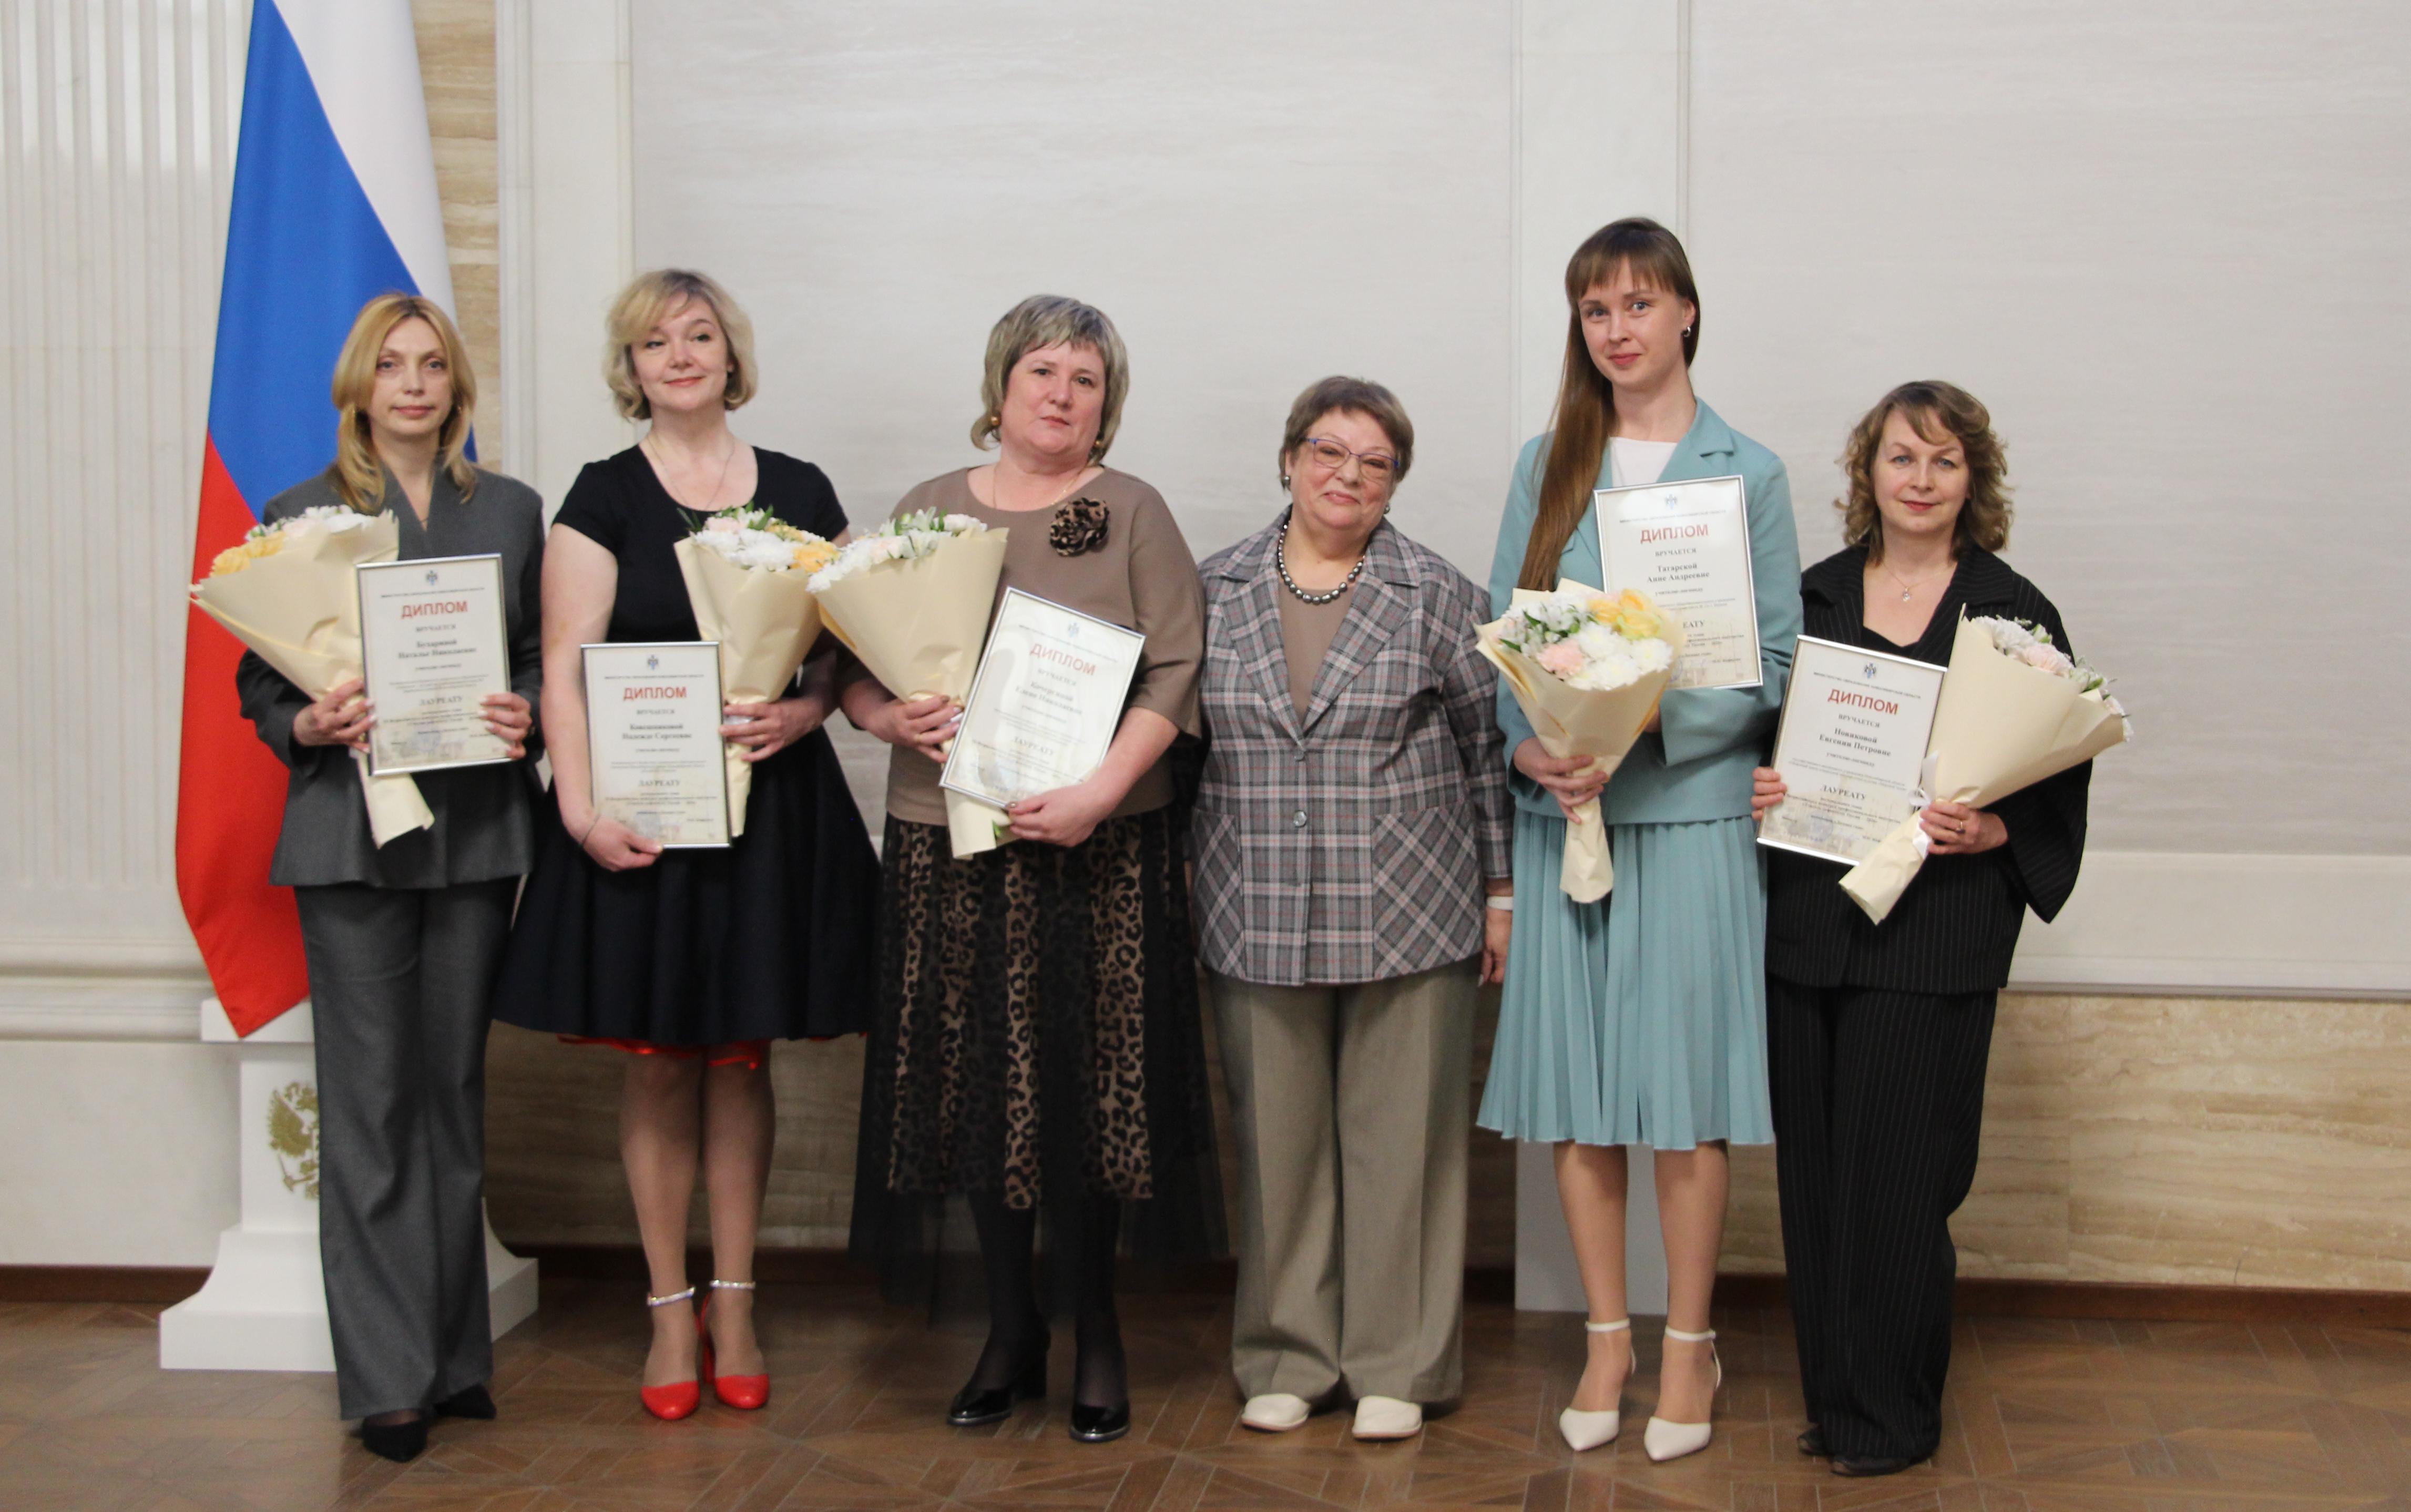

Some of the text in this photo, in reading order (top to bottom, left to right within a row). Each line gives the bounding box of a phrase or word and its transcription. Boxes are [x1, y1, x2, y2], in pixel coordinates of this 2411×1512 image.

[1640, 524, 1709, 544] ДИПЛОМ
[1655, 547, 1697, 557] ВРУЧАЕТСЯ
[402, 601, 467, 618] ДИПЛОМ
[1030, 643, 1095, 676] ДИПЛОМ
[624, 687, 686, 701] ДИПЛОМ
[1827, 689, 1898, 716] ДИПЛОМ
[1838, 713, 1880, 728] ВРУЧАЕТСЯ
[1834, 727, 1877, 744] Новиковой
[1819, 734, 1892, 757] Евгении Петровне
[1821, 785, 1865, 800] ЛАУРЕАТУ
